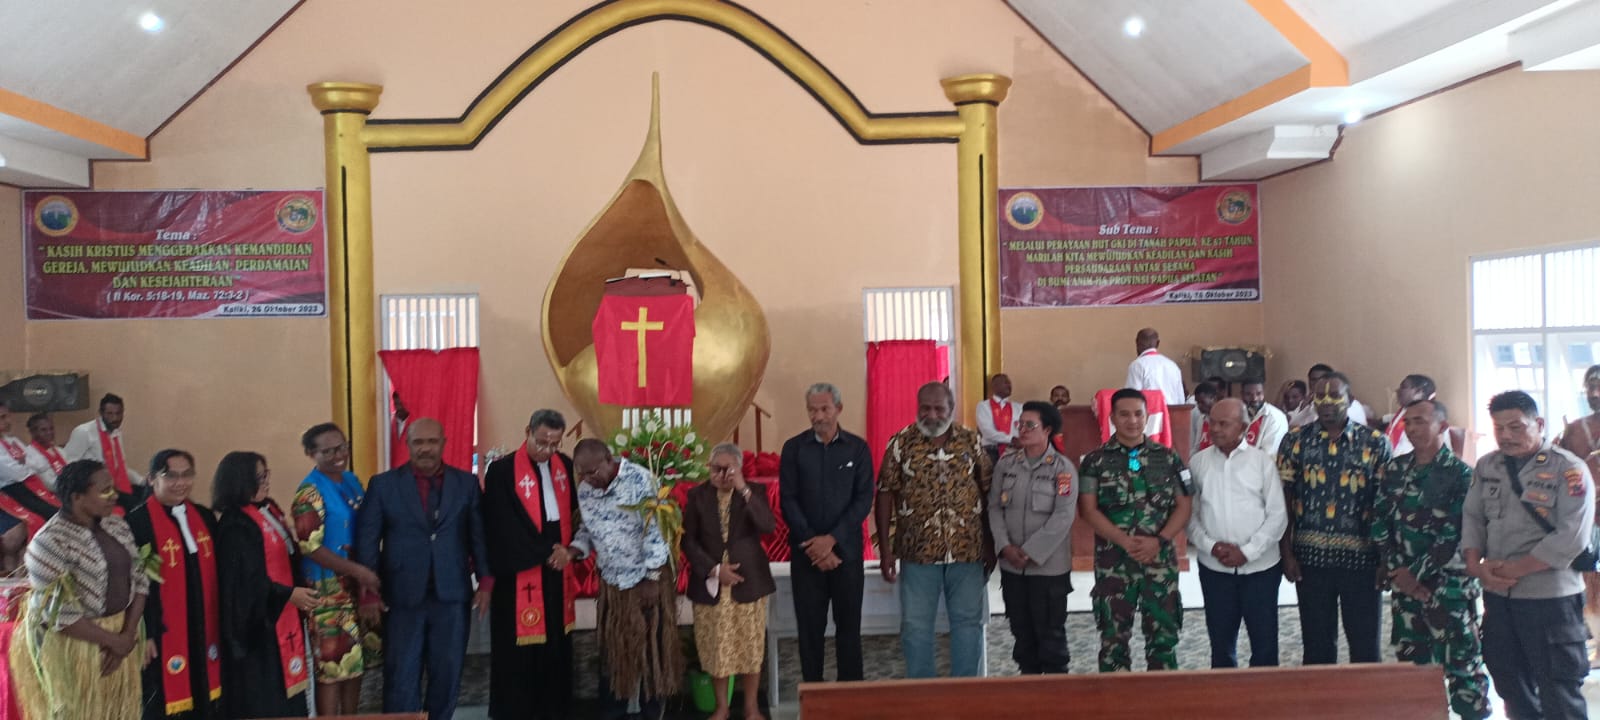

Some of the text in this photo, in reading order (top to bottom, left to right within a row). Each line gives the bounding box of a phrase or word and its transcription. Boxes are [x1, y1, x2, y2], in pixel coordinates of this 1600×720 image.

[155, 229, 190, 240] Tema
[1099, 224, 1120, 235] Sub
[1122, 223, 1152, 234] Tema
[1009, 241, 1045, 250] MELALUI
[1092, 239, 1109, 249] HUT
[1127, 238, 1137, 248] DI
[1140, 238, 1166, 248] TANAH
[1168, 237, 1197, 247] PAPUA
[47, 245, 83, 257] KASIH
[86, 245, 135, 257] KRISTUS
[138, 243, 231, 256] MENGGERAKKAN
[235, 243, 312, 256] KEMANDIRIAN
[1065, 252, 1084, 262] KITA
[1147, 249, 1187, 260] KEADILAN
[1189, 249, 1206, 258] DAN
[1208, 248, 1232, 258] KASIH
[91, 261, 170, 273] MEWUJUDKAN
[235, 259, 309, 271] PERDAMAIAN
[1133, 262, 1159, 272] ANTAR
[113, 277, 137, 288] DAN
[1038, 277, 1047, 287] DI
[1151, 273, 1179, 284] PAPUA
[123, 291, 143, 302] Kor.
[1206, 290, 1233, 299] Oktober
[264, 305, 297, 313] Oktober
[298, 305, 318, 313] 2023
